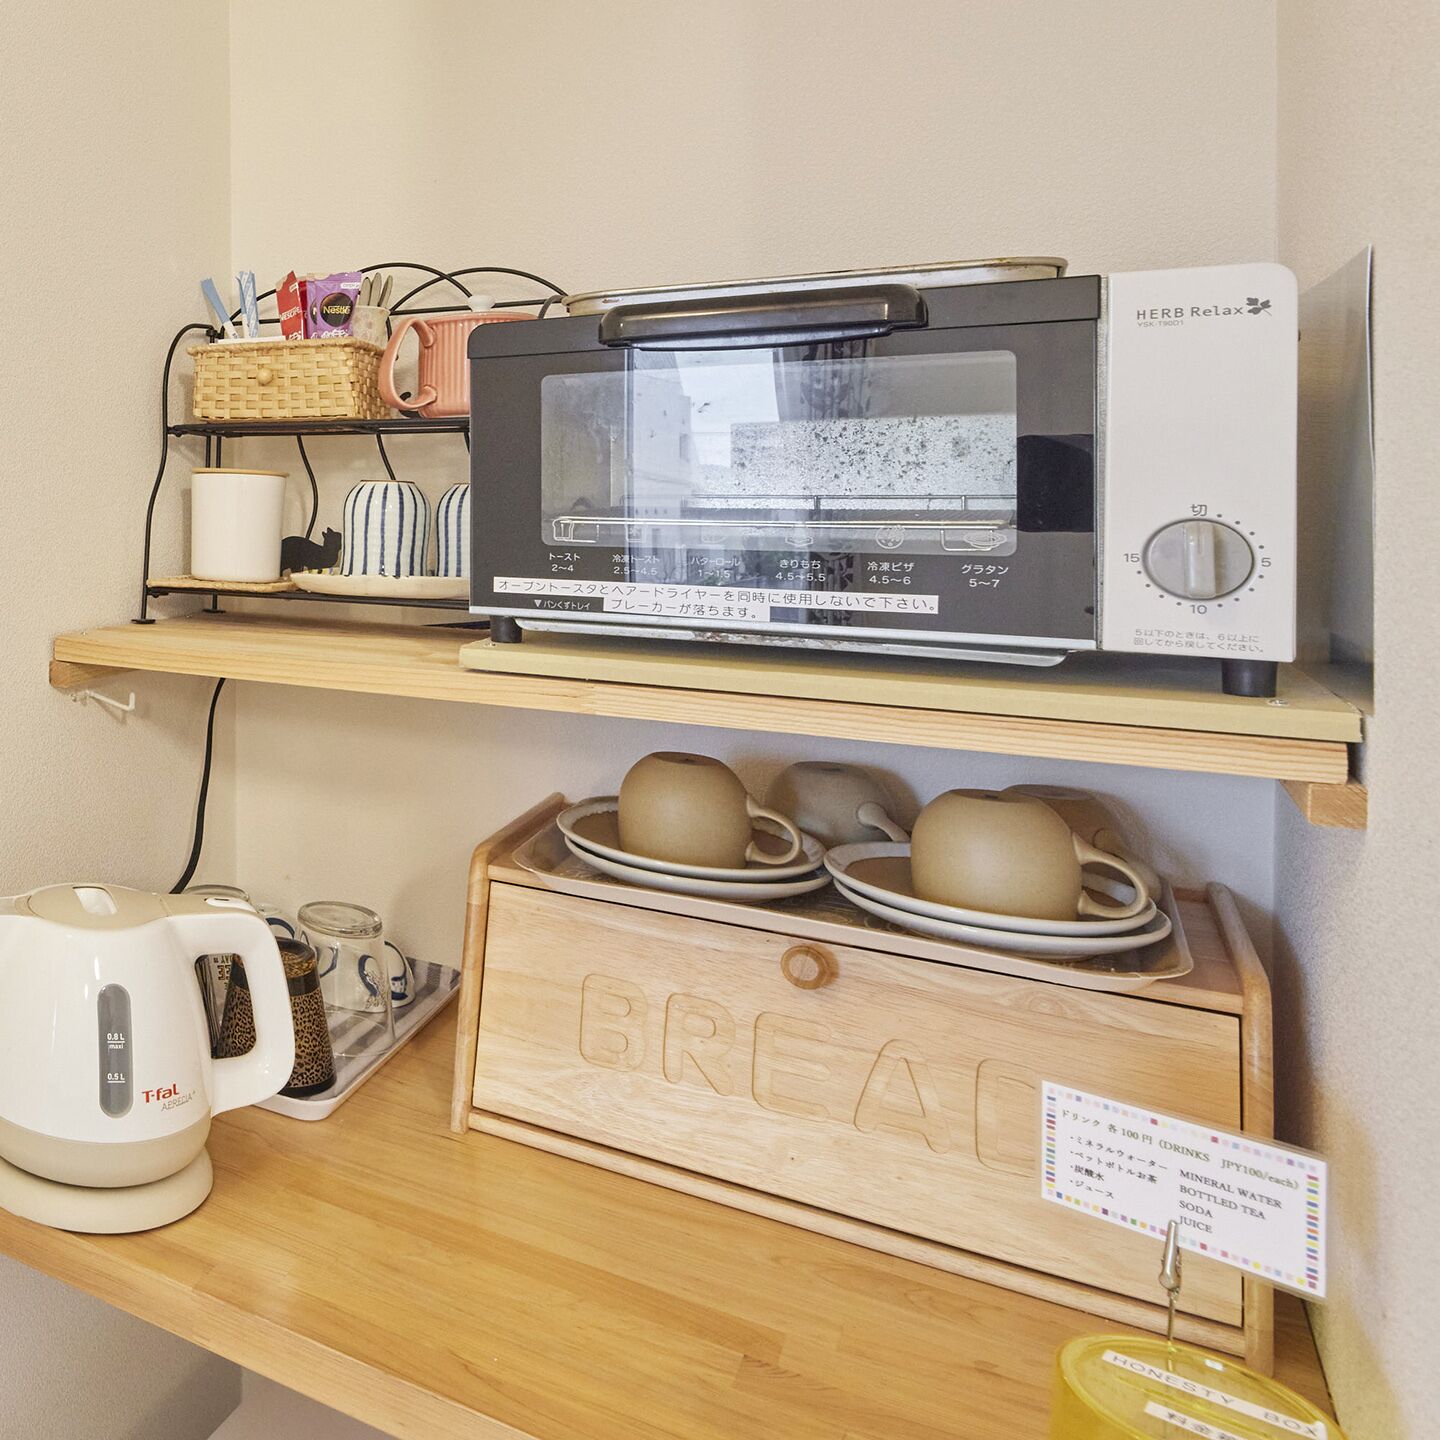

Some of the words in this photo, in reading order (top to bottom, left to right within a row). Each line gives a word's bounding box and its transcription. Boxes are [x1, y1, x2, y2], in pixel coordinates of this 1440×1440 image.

[1137, 307, 1184, 320] HERB
[1191, 306, 1244, 317] Relax
[1190, 503, 1208, 517] 切
[548, 552, 581, 562] トースト
[612, 554, 660, 564] 冷凍トースト
[1123, 553, 1140, 563] 15
[1261, 557, 1272, 567] 5
[779, 559, 822, 569] きりもち
[867, 561, 915, 572] 冷凍ピザ
[961, 564, 1009, 575] グラタン
[1190, 604, 1208, 614] 10
[1060, 1108, 1101, 1128] ドリンク
[1179, 1168, 1235, 1194] MINERAL
[1237, 1186, 1282, 1209] WATER
[1179, 1184, 1238, 1211] BOTTLED
[1241, 1204, 1266, 1220] TEA
[1179, 1200, 1213, 1218] SODA
[1179, 1215, 1213, 1234] JUICE
[1112, 1355, 1235, 1404] HONESTY
[1263, 1411, 1319, 1438] BOX
